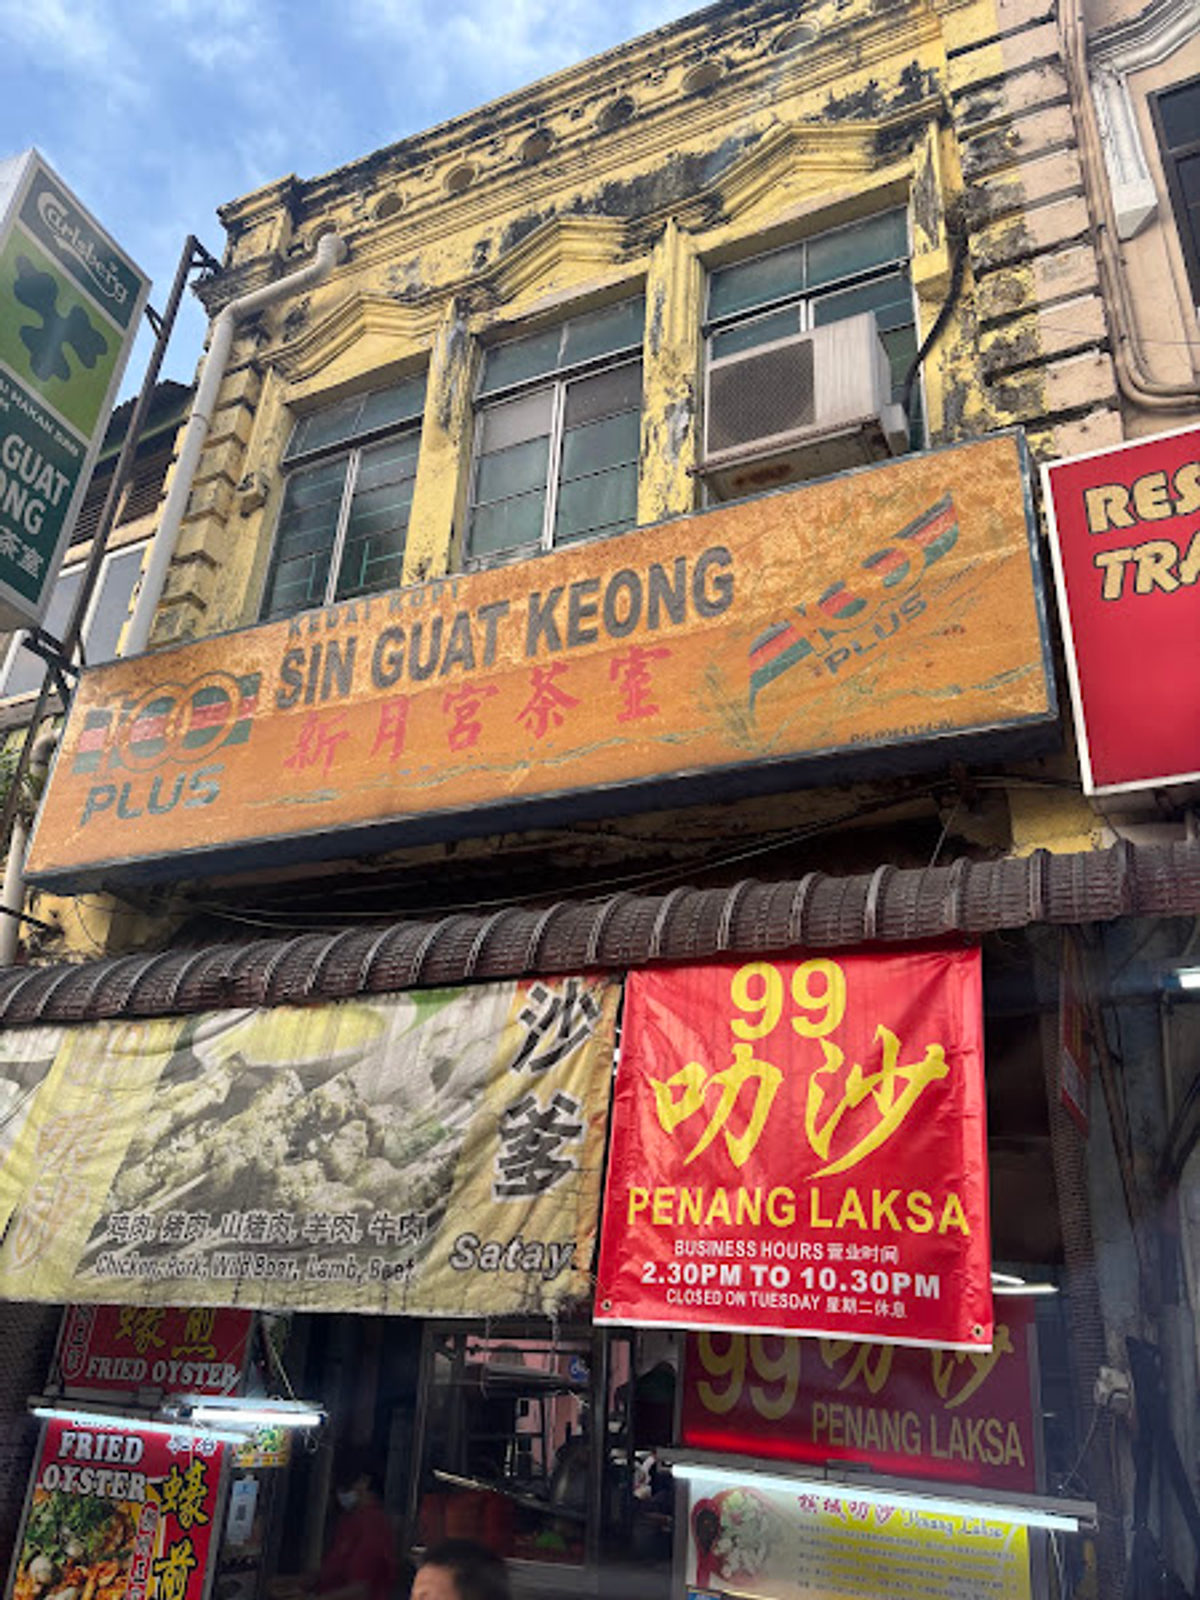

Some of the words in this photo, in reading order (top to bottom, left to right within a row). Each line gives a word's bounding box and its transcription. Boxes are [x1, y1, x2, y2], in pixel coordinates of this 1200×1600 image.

[37, 191, 128, 304] Carlsberg
[3, 434, 70, 506] GUAT
[274, 636, 357, 710] SIN
[372, 600, 510, 690] GUAT
[525, 545, 735, 657] KEONG
[823, 592, 927, 675] PLUS
[80, 763, 225, 827] PLUS
[731, 957, 847, 1041] 99
[649, 1024, 951, 1180] 叻沙
[627, 1187, 797, 1228] PENANG
[810, 1187, 970, 1236] LAKSA
[212, 1251, 251, 1280] Wild
[449, 1231, 577, 1281] Satay
[674, 1239, 756, 1259] BUSINESS
[761, 1241, 823, 1261] HOURS
[641, 1261, 742, 1287] 2.30PM
[750, 1264, 791, 1289] TO
[801, 1267, 940, 1300] 10.30PM
[667, 1287, 722, 1307] CLOSED
[726, 1290, 746, 1307] ON
[750, 1292, 820, 1311] TUESDAY
[85, 1356, 148, 1382] FRIED
[152, 1360, 241, 1390] OYSTER
[57, 1430, 144, 1466] FRIED
[811, 1402, 922, 1457] PENANG
[930, 1414, 1026, 1468] LAKSA
[40, 1464, 147, 1503] OYSTER
